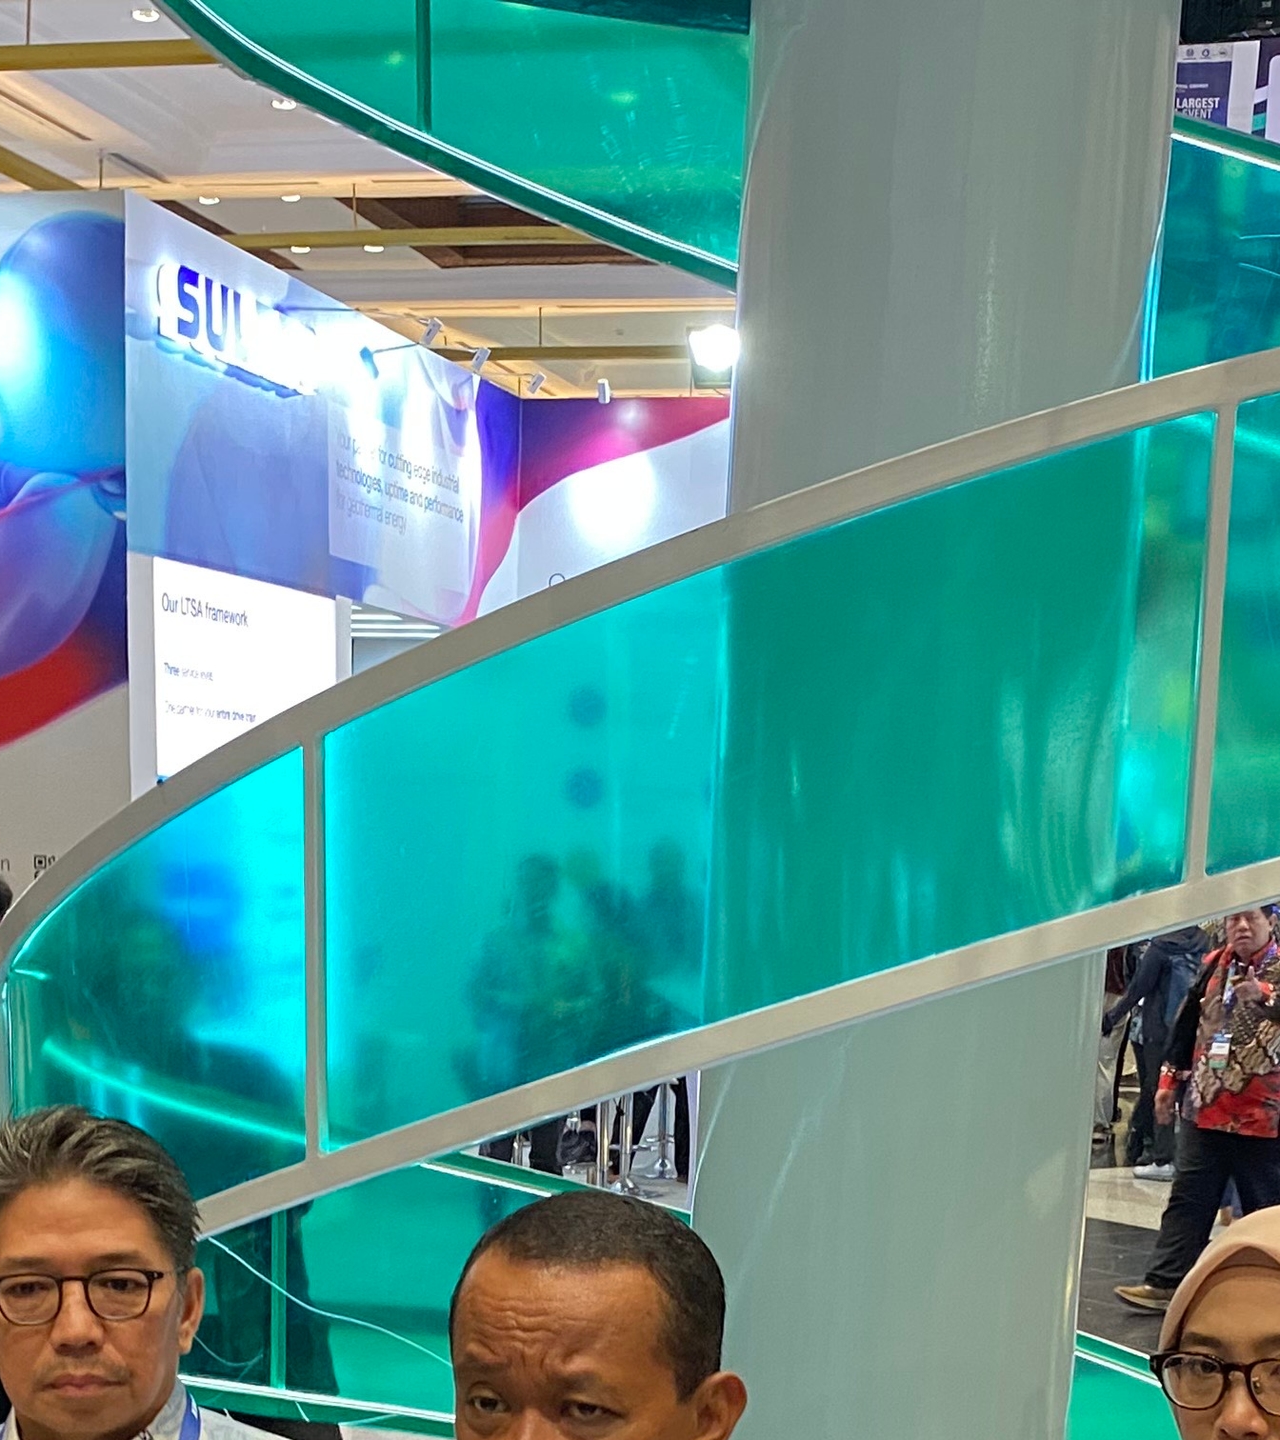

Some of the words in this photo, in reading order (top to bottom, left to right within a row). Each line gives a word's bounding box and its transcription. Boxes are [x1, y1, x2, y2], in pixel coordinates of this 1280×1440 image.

[1176, 97, 1220, 109] LARGEST
[161, 592, 178, 613] Our
[180, 596, 203, 618] LTSA
[205, 601, 249, 627] framework
